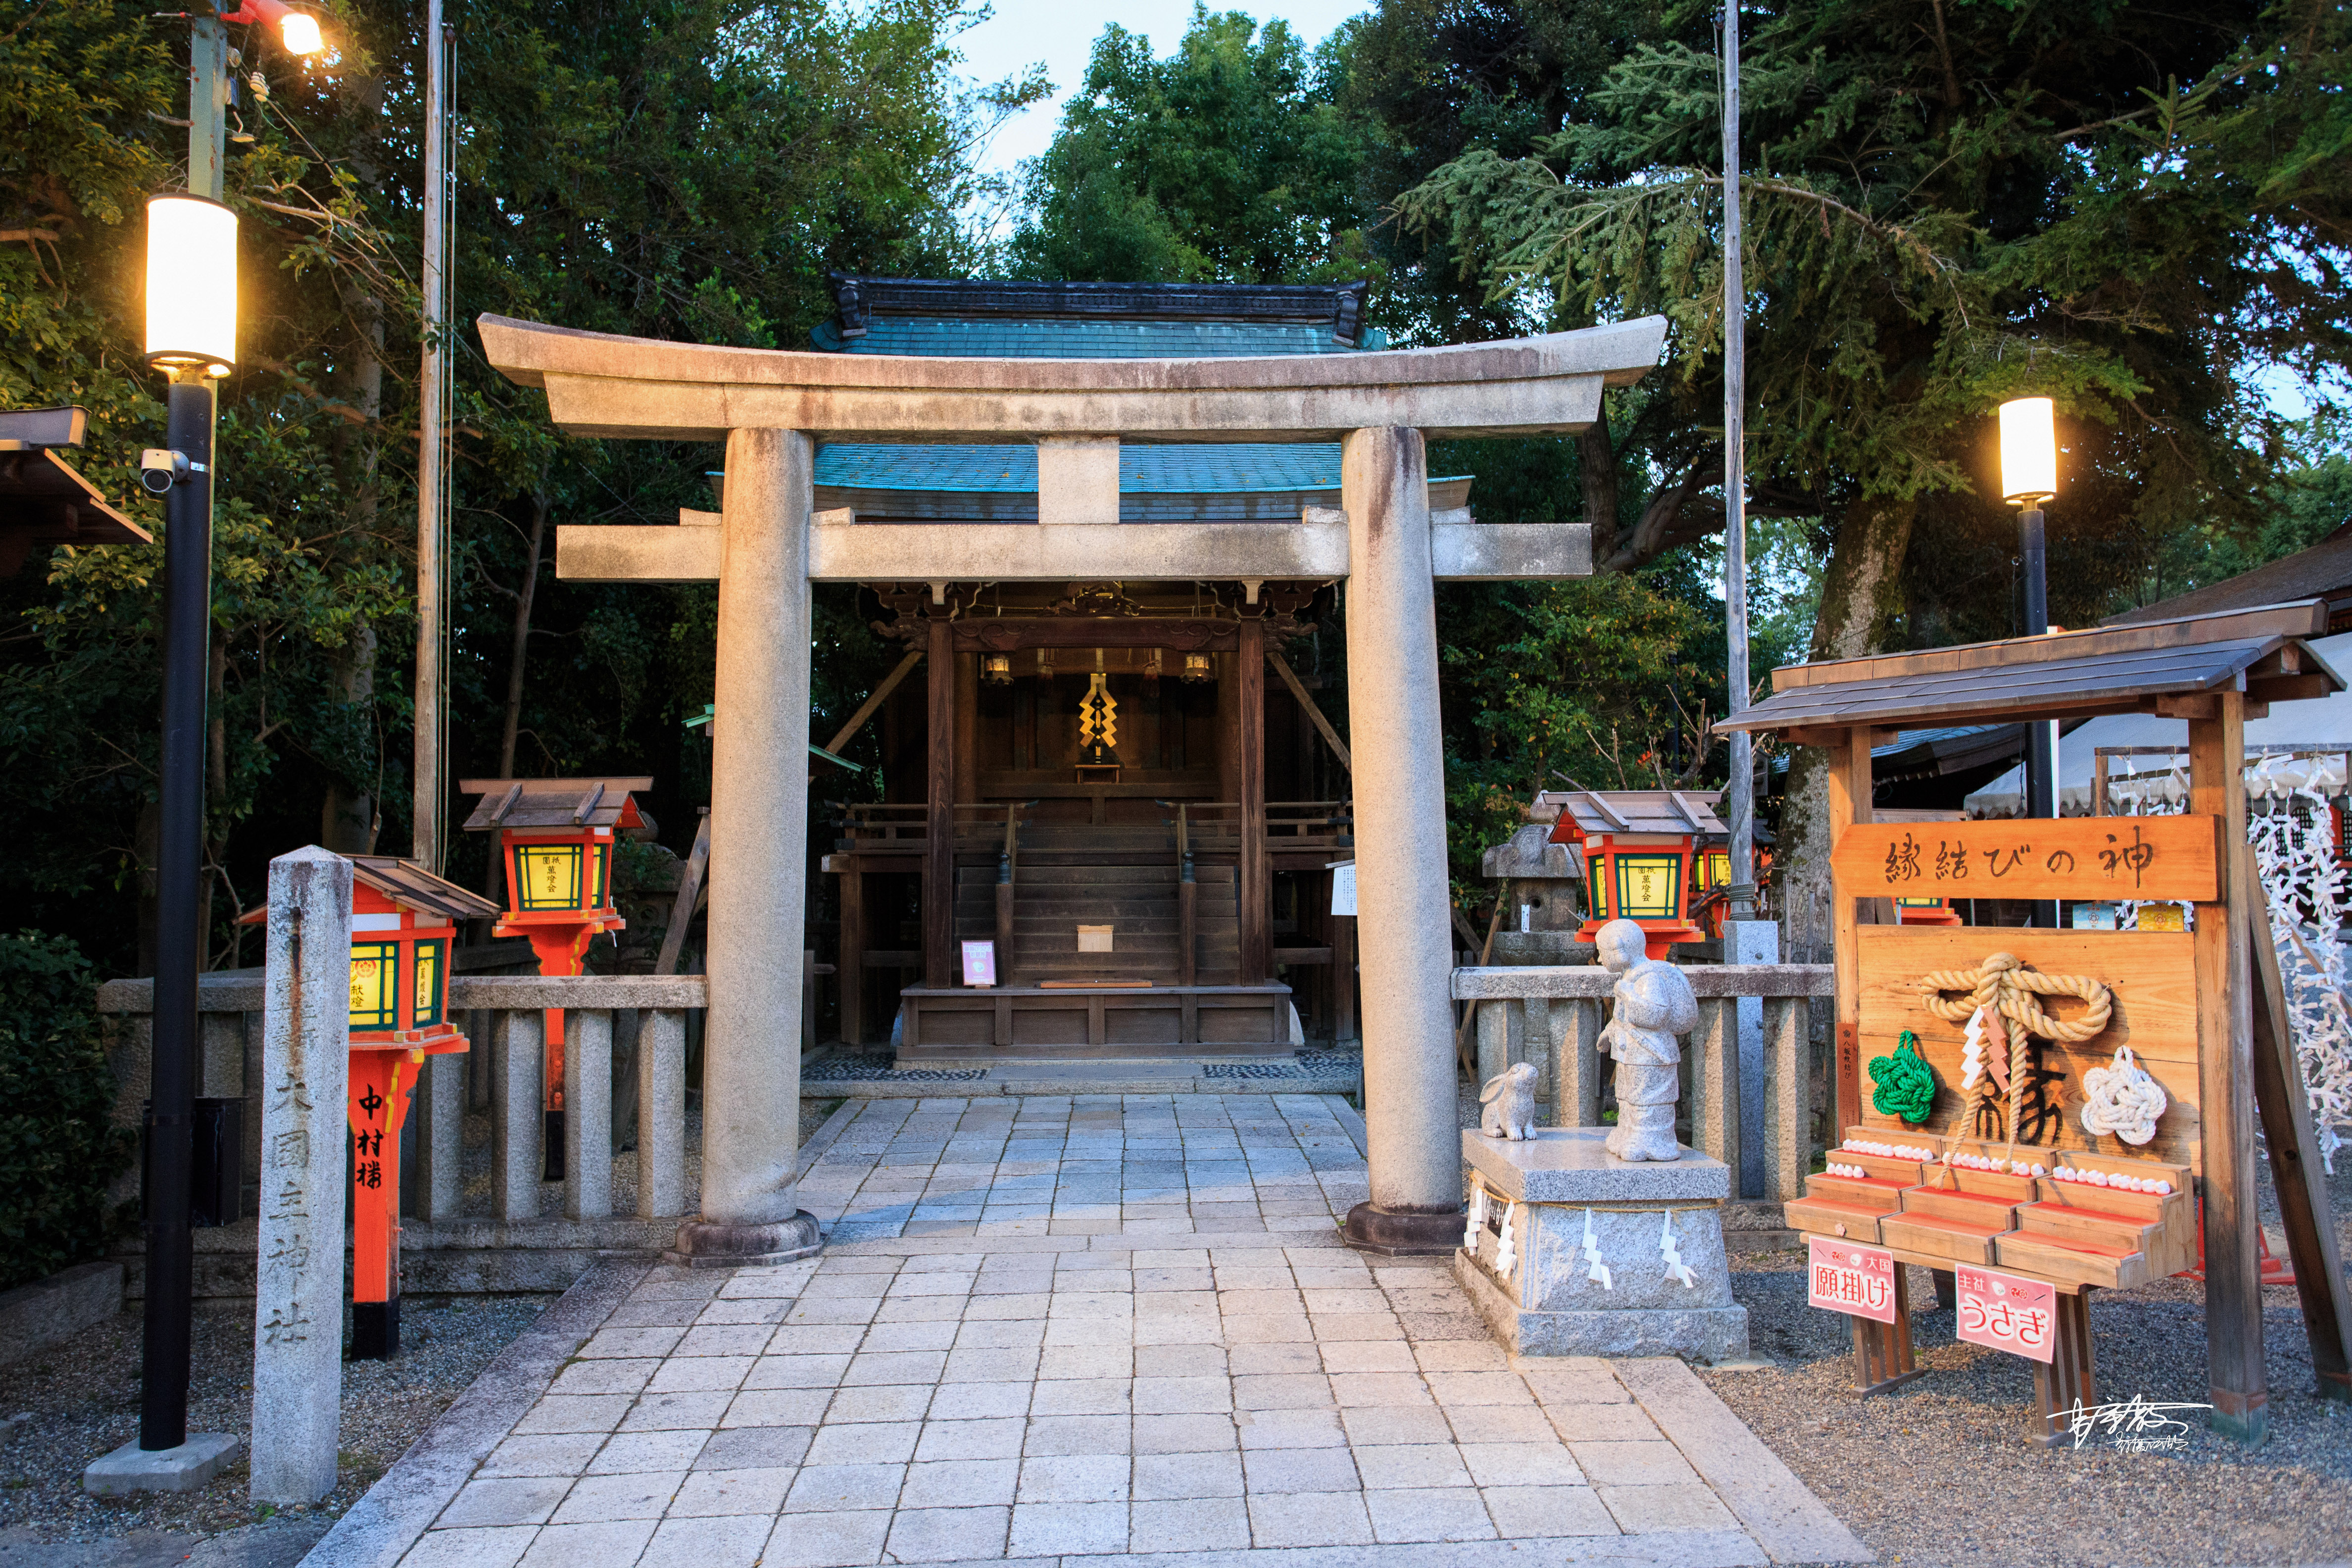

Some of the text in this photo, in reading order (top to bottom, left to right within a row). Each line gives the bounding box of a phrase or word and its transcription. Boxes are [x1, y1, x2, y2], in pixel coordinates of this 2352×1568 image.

[1885, 825, 2154, 888] 縁結びの神
[1866, 1256, 1891, 1273] 大国
[1959, 1274, 1986, 1292] 主社
[1815, 1266, 1889, 1307] 願掛け
[1963, 1297, 2046, 1344] うさぎ
